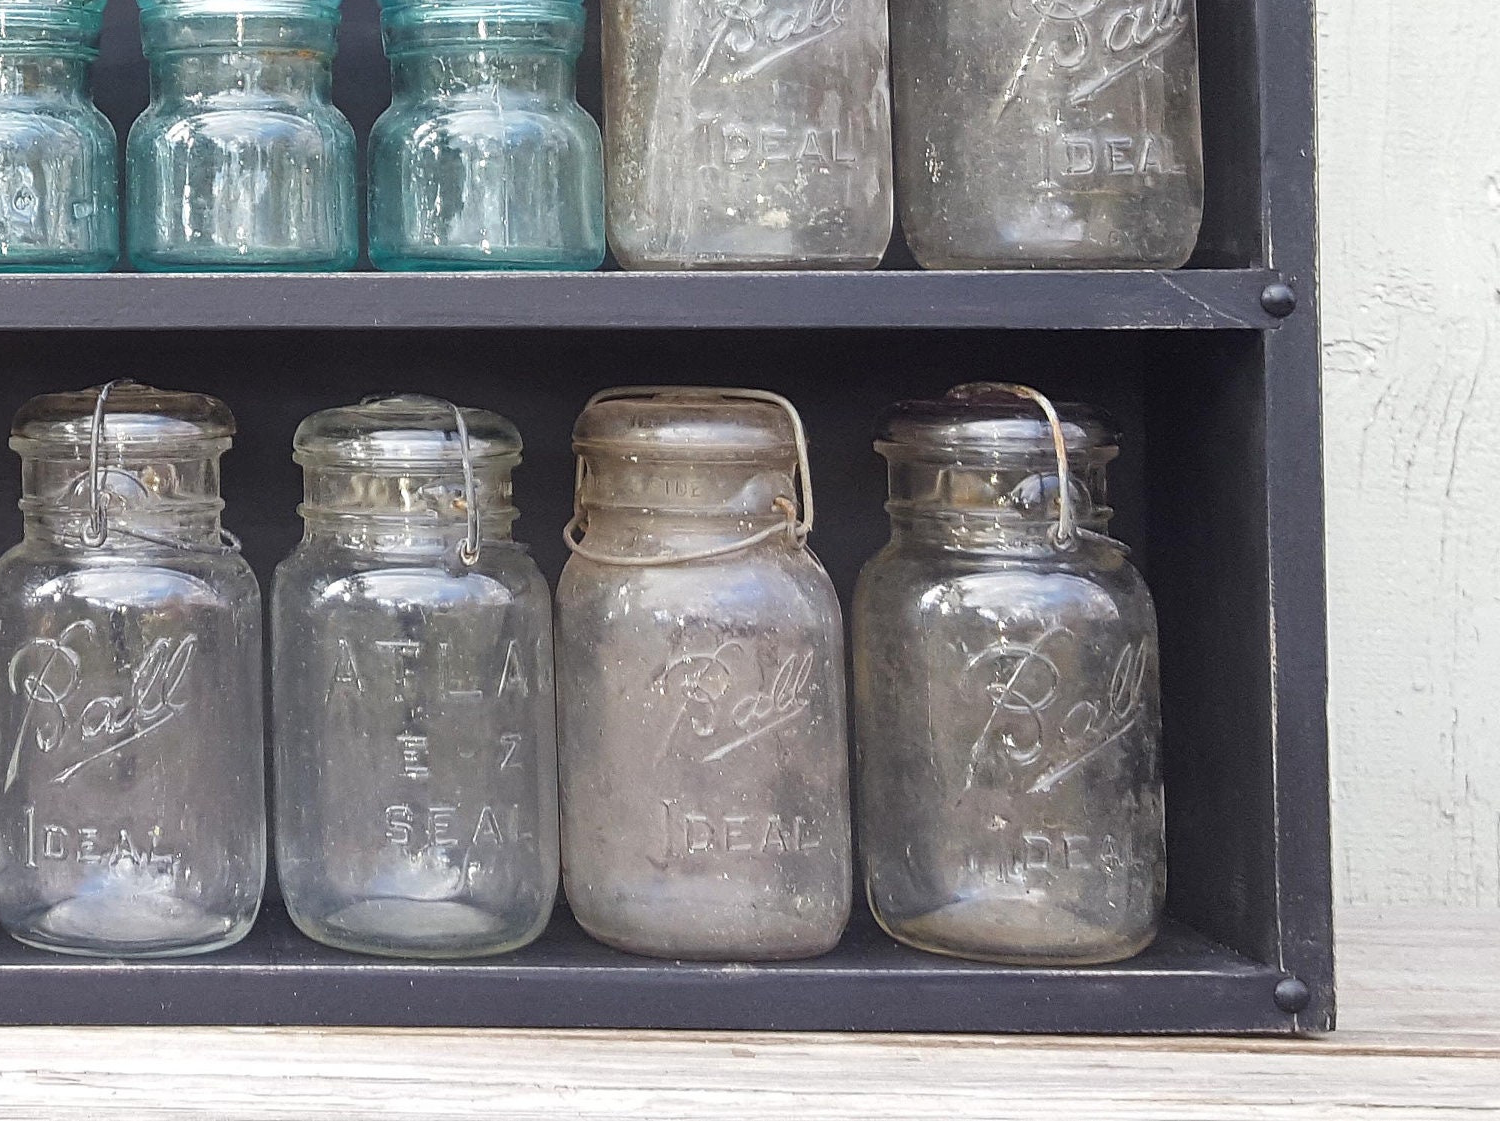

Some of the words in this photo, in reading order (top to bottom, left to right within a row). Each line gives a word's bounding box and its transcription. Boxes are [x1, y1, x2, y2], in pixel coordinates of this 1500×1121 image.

[3, 619, 198, 793] Ball
[652, 642, 814, 767] Ball
[956, 626, 1148, 807] Ball
